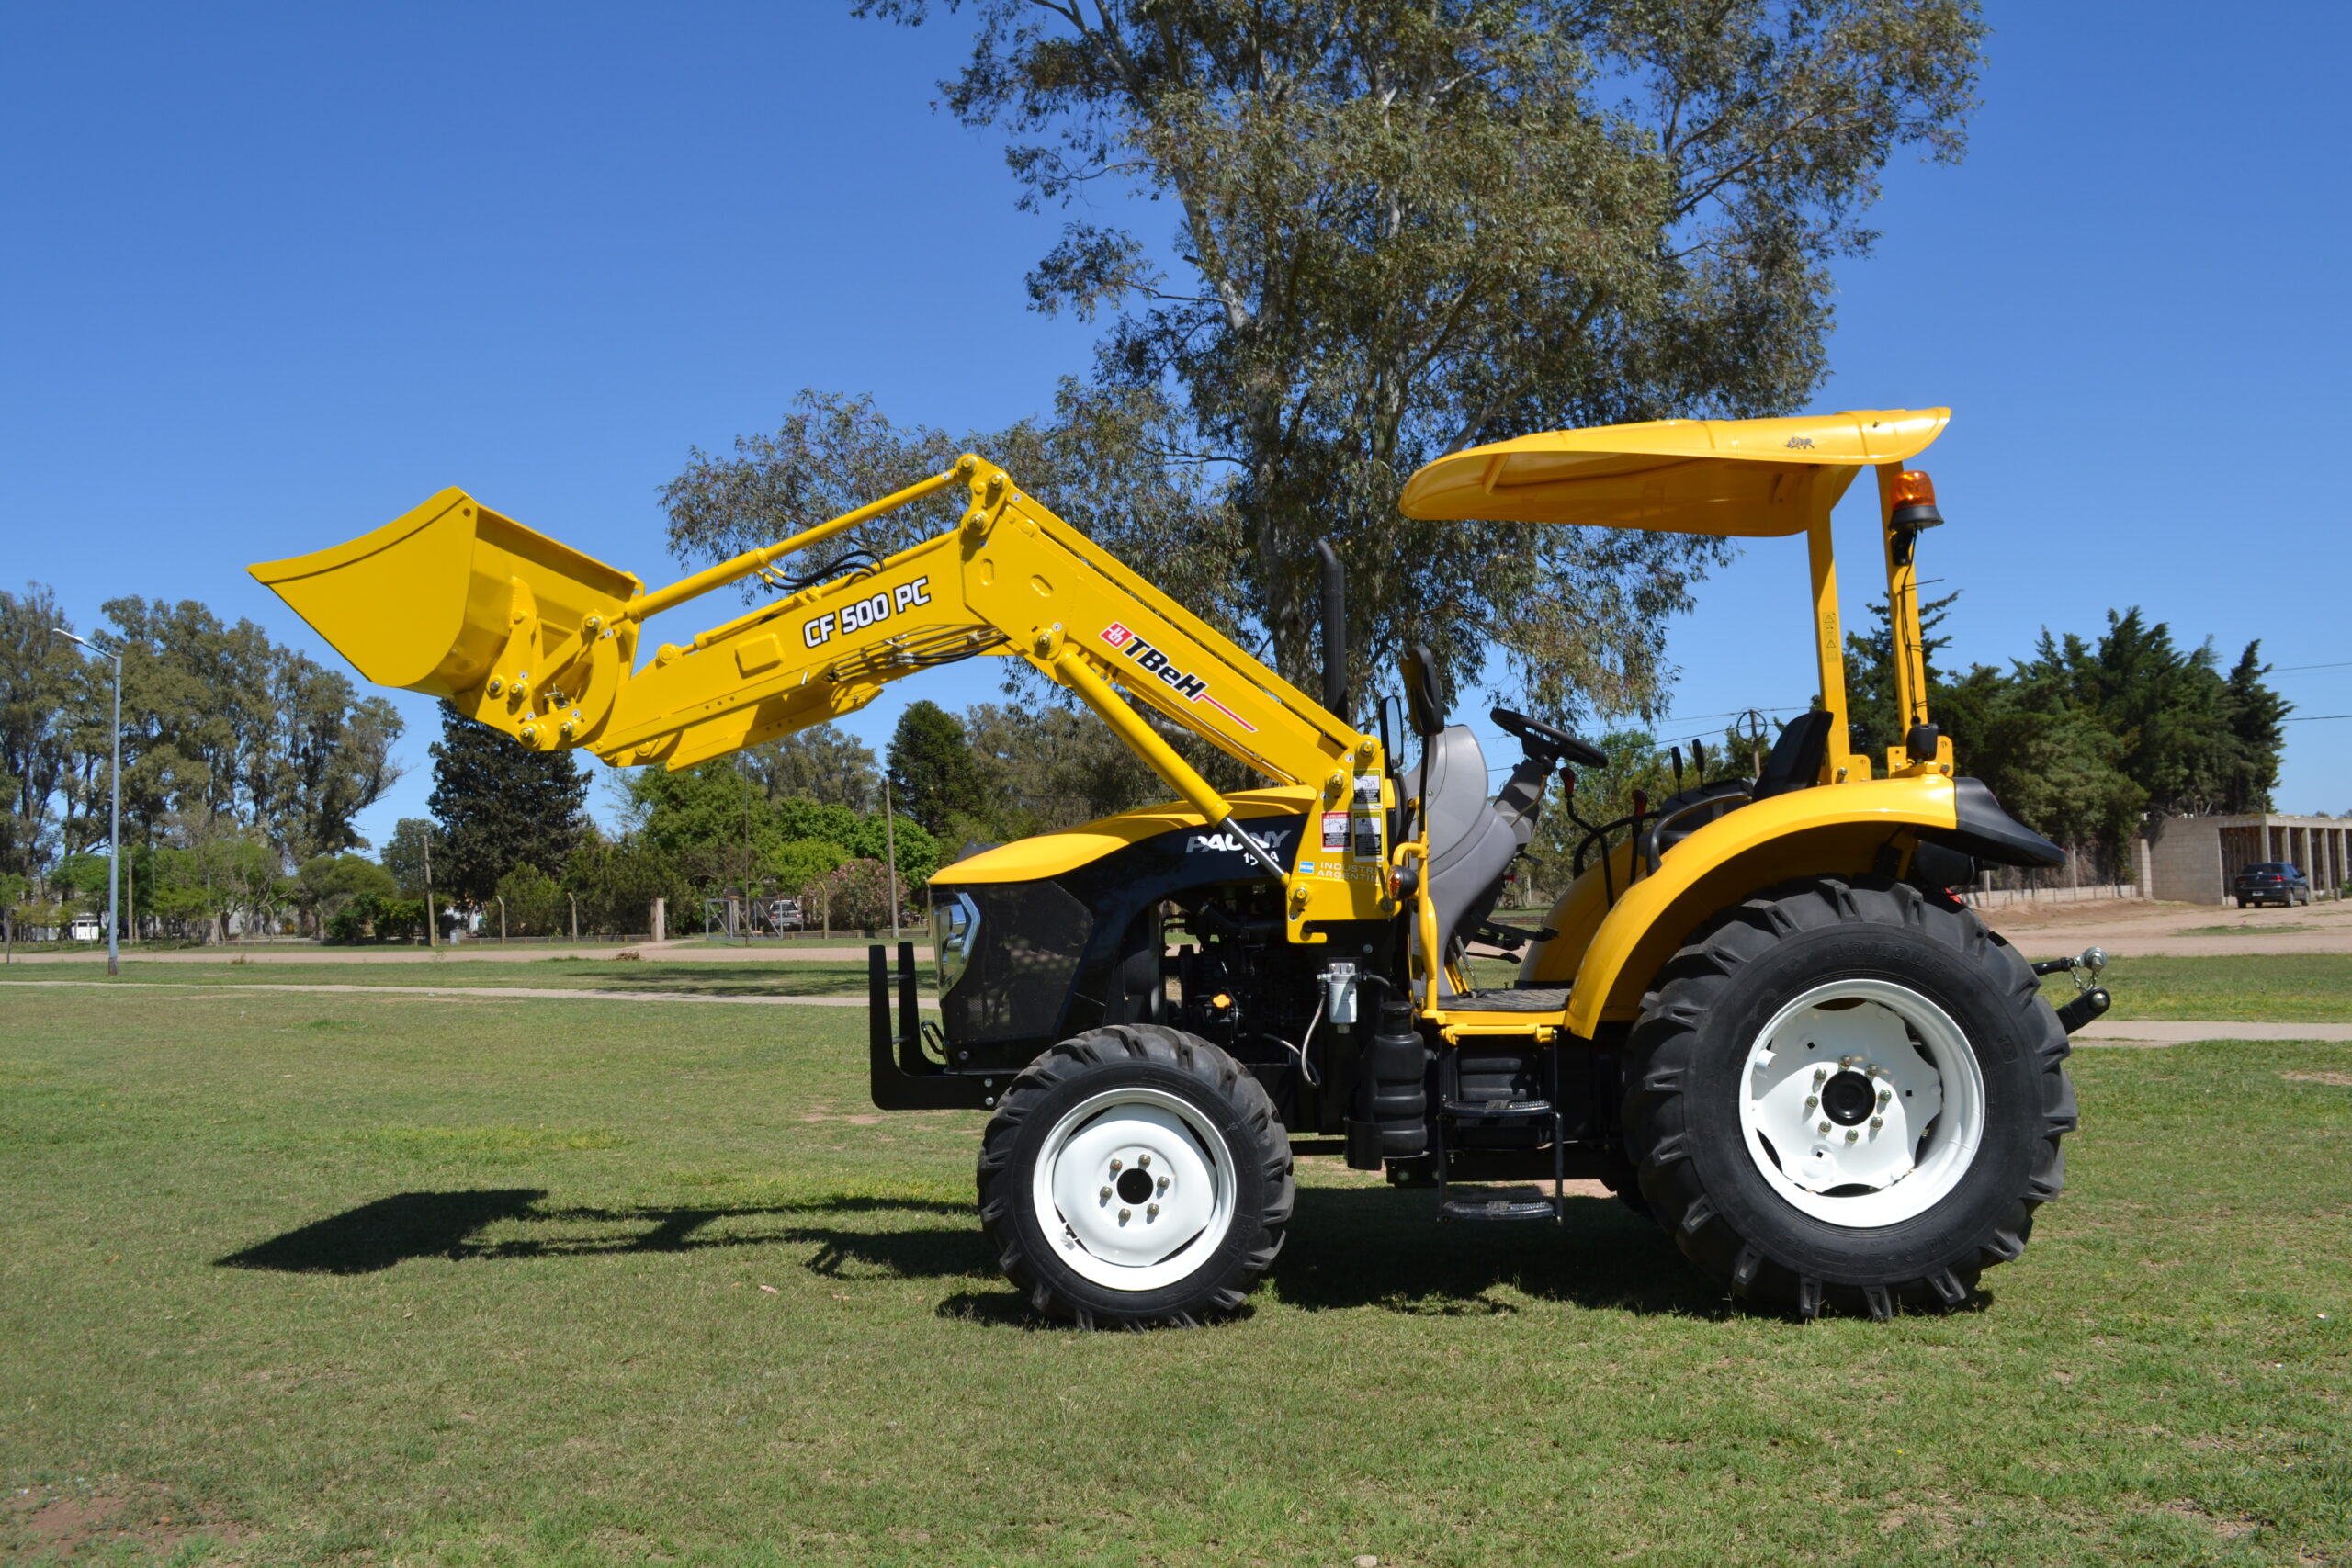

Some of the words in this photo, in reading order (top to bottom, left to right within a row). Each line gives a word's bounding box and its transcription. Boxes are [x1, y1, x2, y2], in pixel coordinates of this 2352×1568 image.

[803, 611, 836, 649] CF
[840, 592, 890, 635] 500
[893, 575, 932, 615] PC
[1122, 635, 1209, 700] TBeH
[1185, 829, 1292, 853] PAUNY
[1317, 870, 1379, 883] ARGENTIN
[1320, 861, 1377, 874] INDUSTRI
